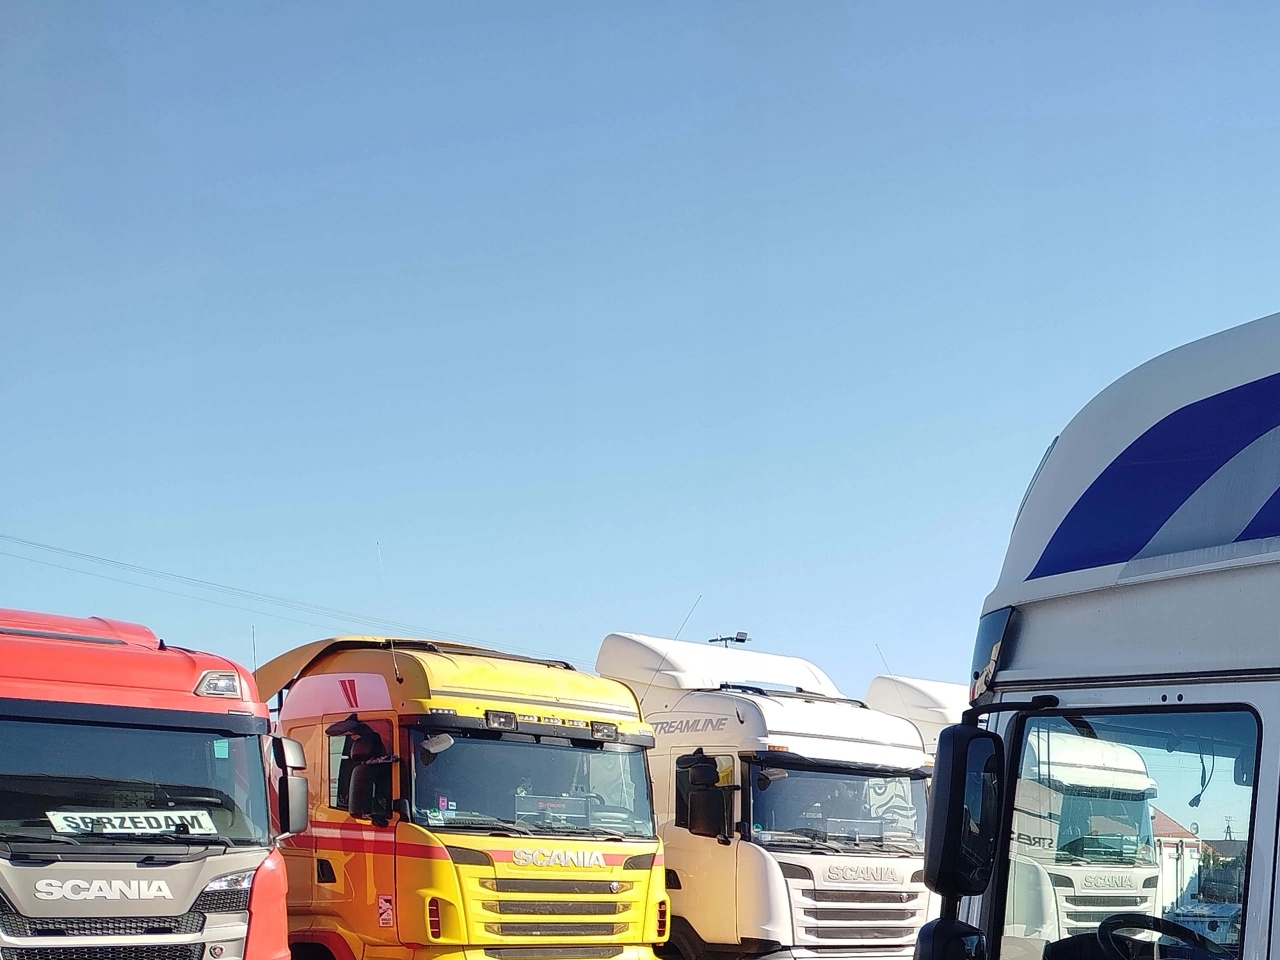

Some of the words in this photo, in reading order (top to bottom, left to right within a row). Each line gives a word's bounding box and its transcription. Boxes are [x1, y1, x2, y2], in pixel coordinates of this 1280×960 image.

[651, 718, 729, 735] TREAMLINE
[62, 815, 204, 831] SPRZEDAM
[513, 848, 607, 868] SCANIA
[828, 864, 899, 882] SCANIA
[1083, 874, 1134, 888] SCANIA
[34, 879, 174, 900] SCANIA
